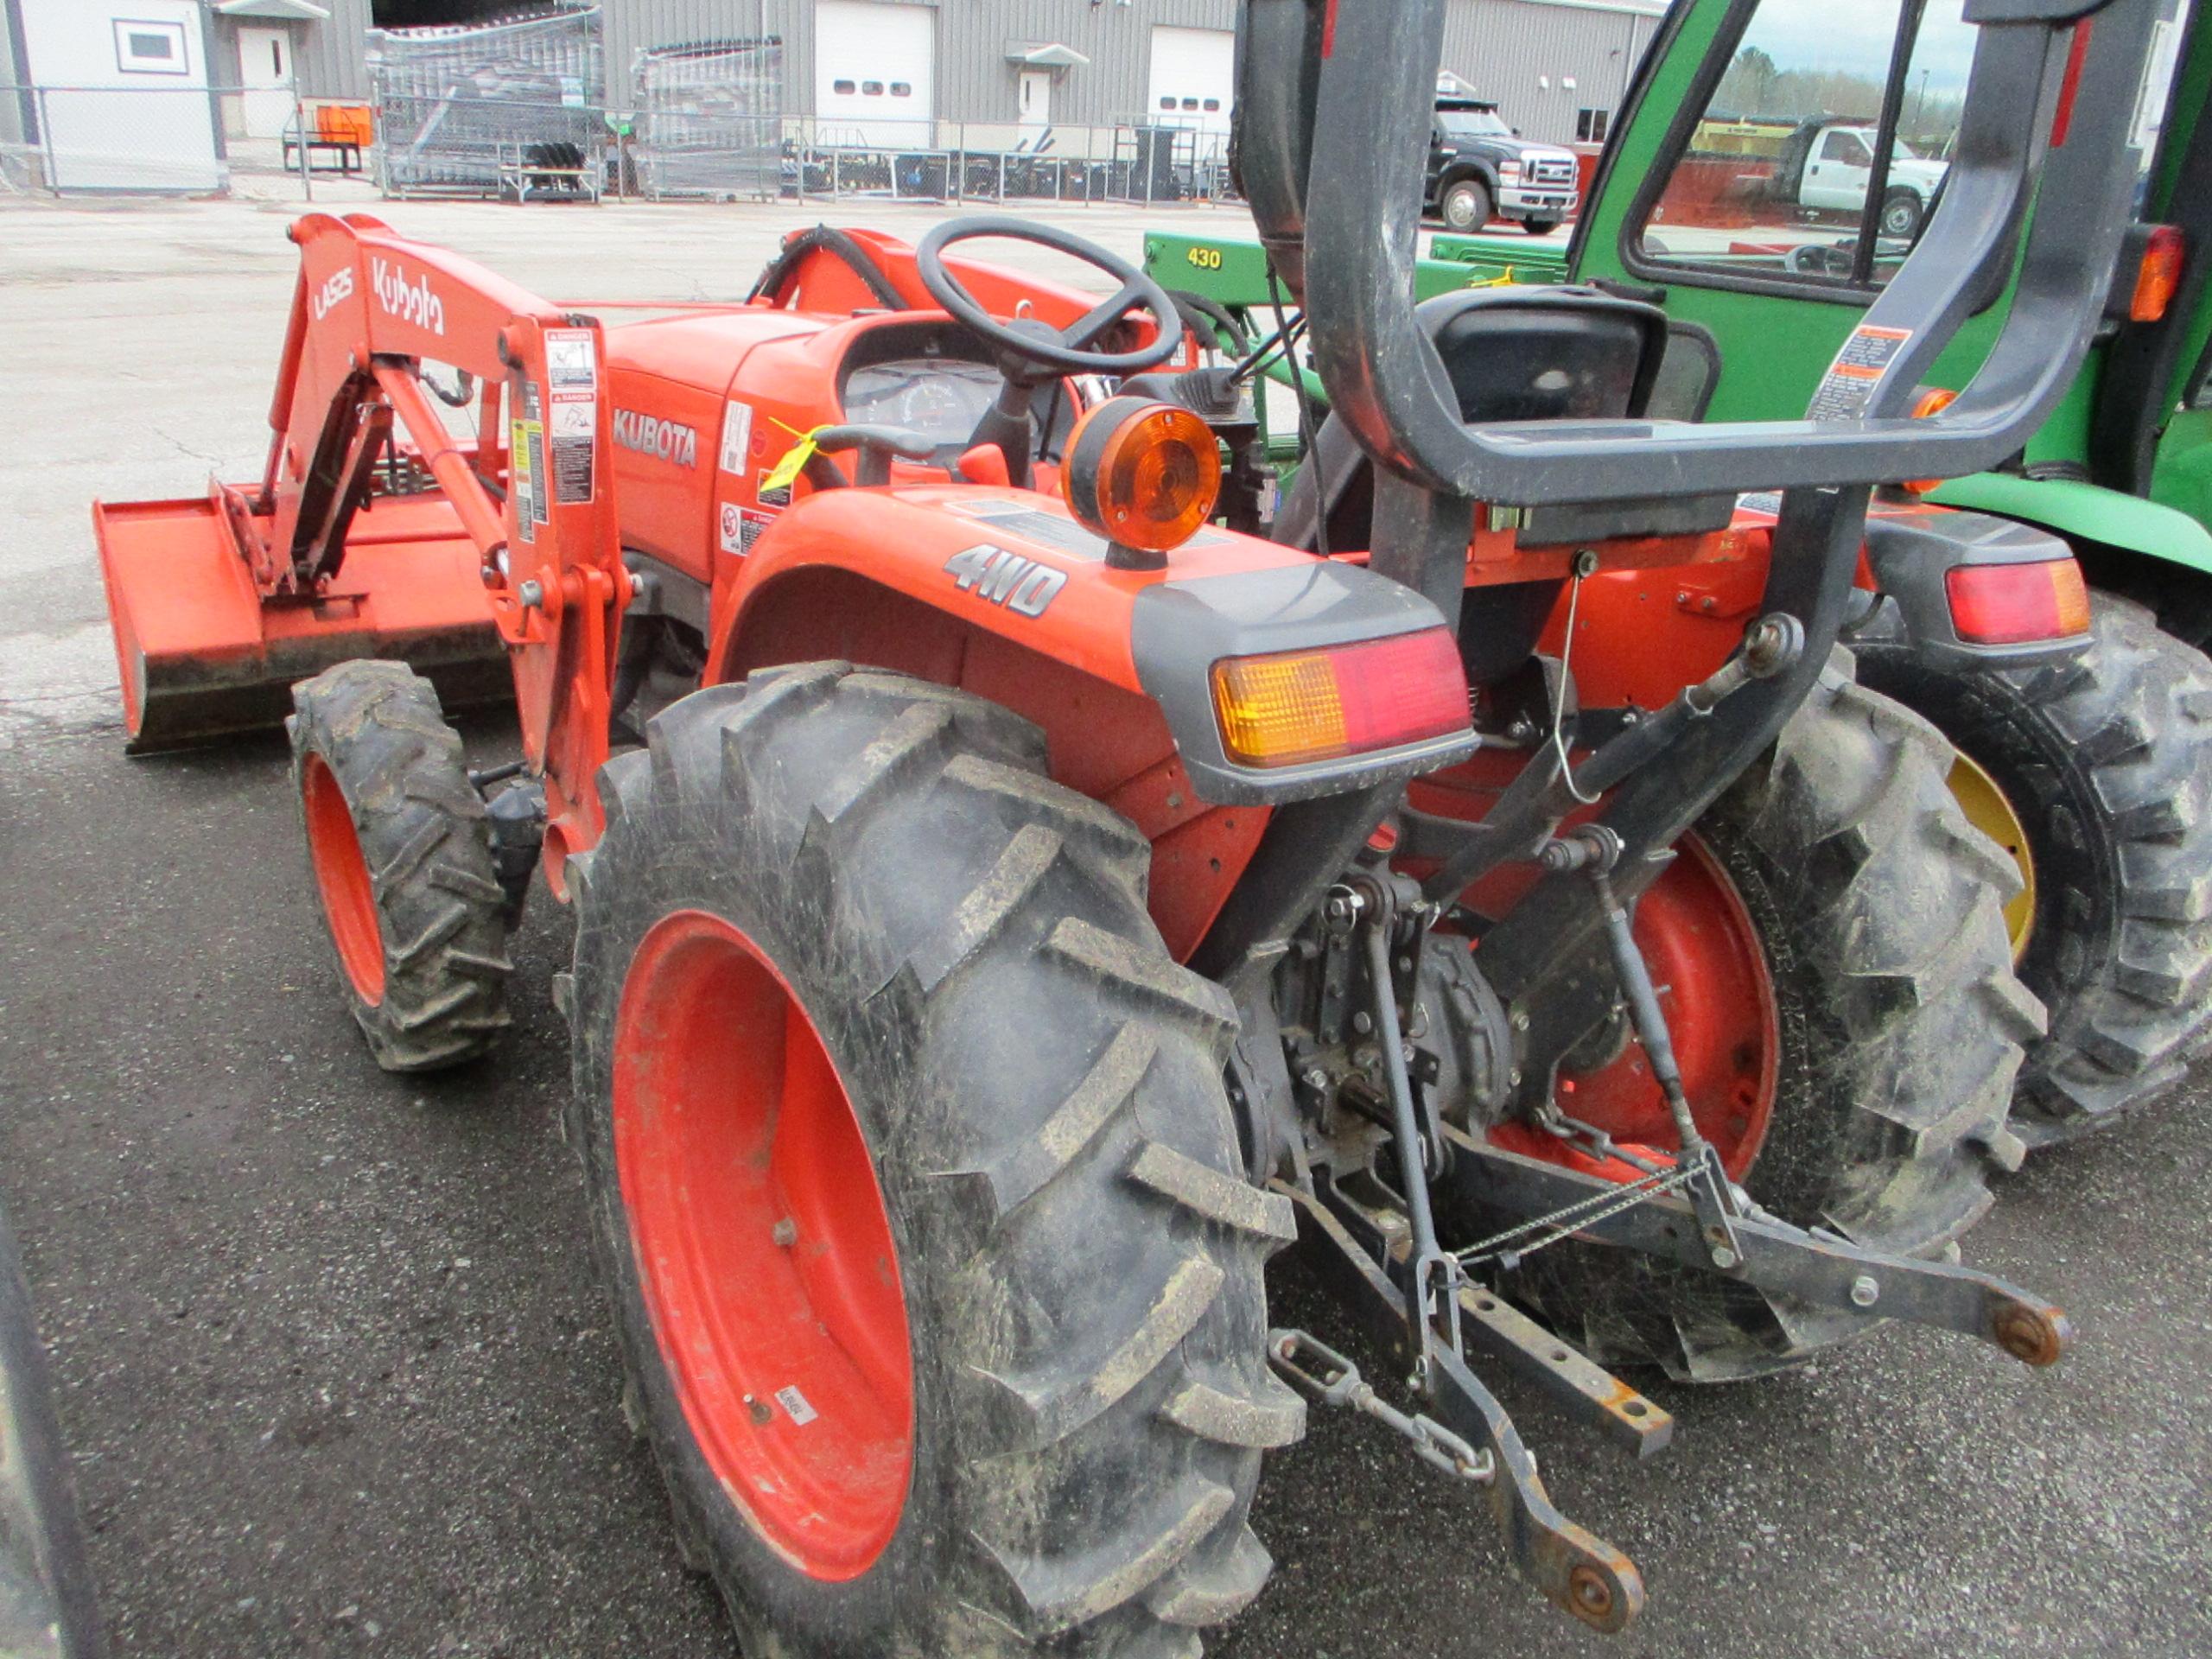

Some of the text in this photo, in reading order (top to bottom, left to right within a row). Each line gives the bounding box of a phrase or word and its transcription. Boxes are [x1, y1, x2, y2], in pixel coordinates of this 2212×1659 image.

[1187, 247, 1221, 270] 430
[315, 266, 353, 321] LA525
[372, 256, 444, 336] Kubota
[613, 408, 697, 469] KUBOTA
[942, 543, 1069, 620] 4WD
